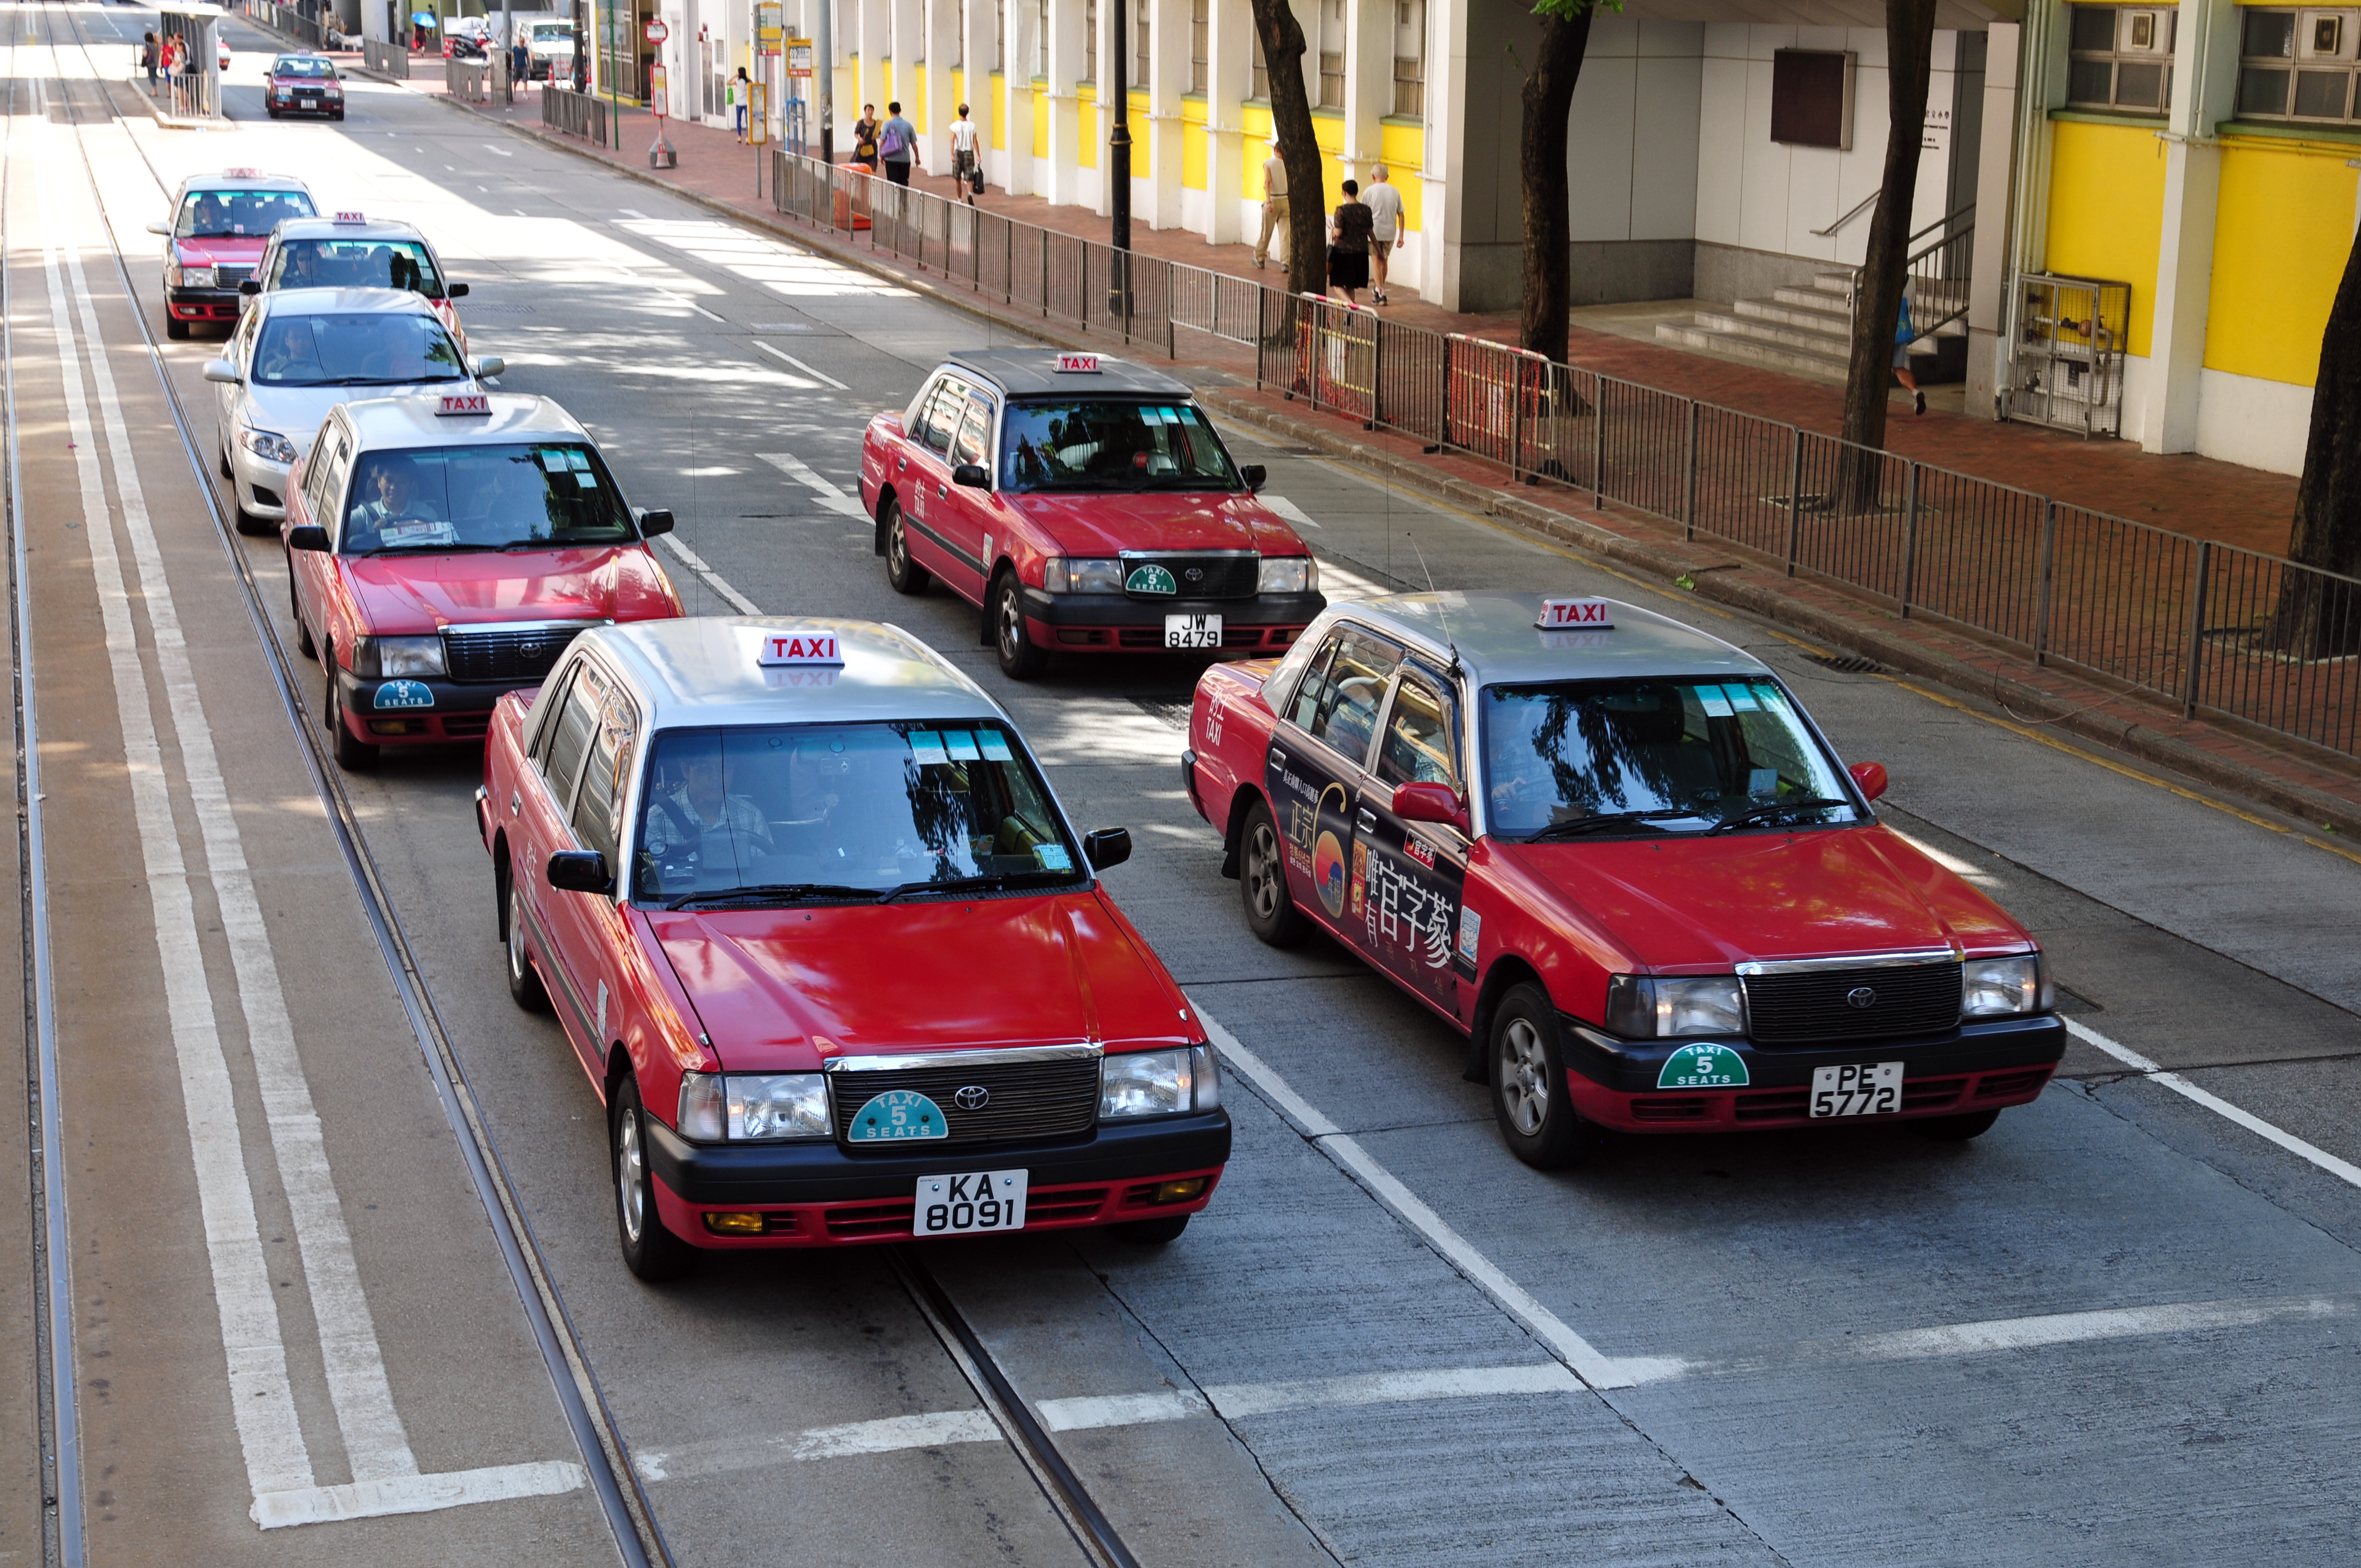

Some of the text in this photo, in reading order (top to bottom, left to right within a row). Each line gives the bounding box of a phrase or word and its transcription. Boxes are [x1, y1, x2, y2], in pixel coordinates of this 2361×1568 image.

[228, 168, 263, 177] TAXI
[337, 212, 362, 221] TAXI
[1063, 358, 1096, 369] TAXI
[443, 397, 485, 410] TAXI
[914, 494, 925, 519] TAXI
[1142, 567, 1165, 576] TAXI
[1148, 574, 1157, 585] 5
[1135, 583, 1167, 592] SEATS
[1182, 614, 1207, 630] JW
[1553, 604, 1606, 623] TAXI
[773, 639, 834, 657] TAXI
[1169, 631, 1218, 648] 8479
[398, 685, 409, 699] 5
[384, 698, 423, 706] SEATS
[1209, 689, 1230, 721] 的士
[1206, 716, 1222, 747] TAXI
[1290, 799, 1313, 850] 正宗
[525, 868, 536, 913] TAXI
[1364, 848, 1379, 948] 唯有
[1685, 1046, 1722, 1057] TAXI
[1695, 1056, 1713, 1074] 5
[1677, 1075, 1731, 1085] SEATS
[1837, 1064, 1878, 1091] PE
[875, 1093, 922, 1109] TAXI
[1814, 1087, 1895, 1117] 5772
[891, 1106, 907, 1126] 5
[867, 1125, 931, 1138] SEATS
[949, 1174, 994, 1202] KA
[926, 1199, 1014, 1231] 8091
